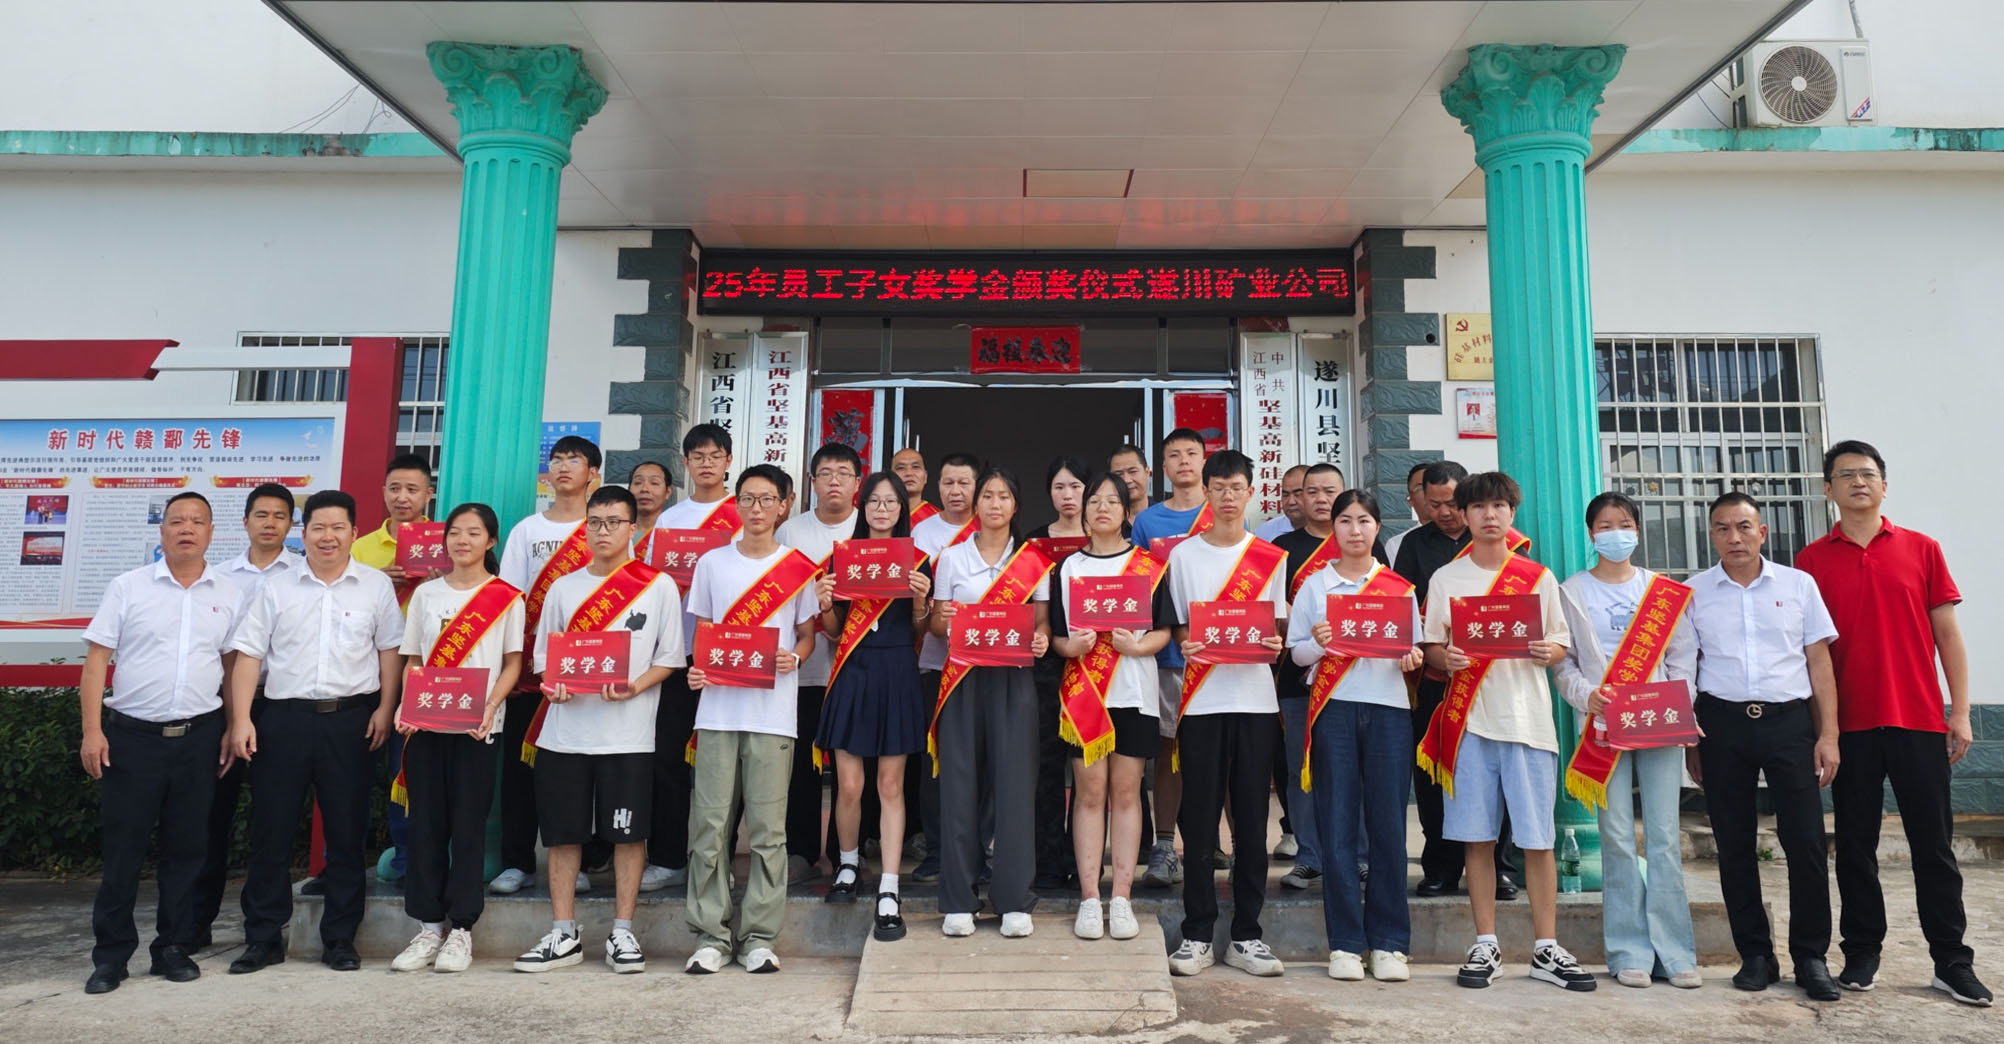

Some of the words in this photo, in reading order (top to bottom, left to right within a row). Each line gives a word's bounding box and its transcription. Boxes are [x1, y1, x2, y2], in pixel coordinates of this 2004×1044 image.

[1314, 360, 1341, 464] 遂川县坚
[48, 429, 241, 450] 新时代赣鄱先锋
[847, 562, 902, 580] 奖学金
[1083, 597, 1138, 614] 奖学金
[965, 628, 1020, 646] 奖学金
[1204, 626, 1262, 645] 奖学金
[1341, 619, 1398, 639] 奖学金
[1467, 620, 1528, 639] 奖学金
[1612, 587, 1681, 686] 广东坚基集团奖学
[560, 655, 616, 674] 奖学金
[709, 648, 764, 669] 奖学金
[416, 692, 473, 710] 奖学金
[1620, 707, 1680, 730] 奖学金
